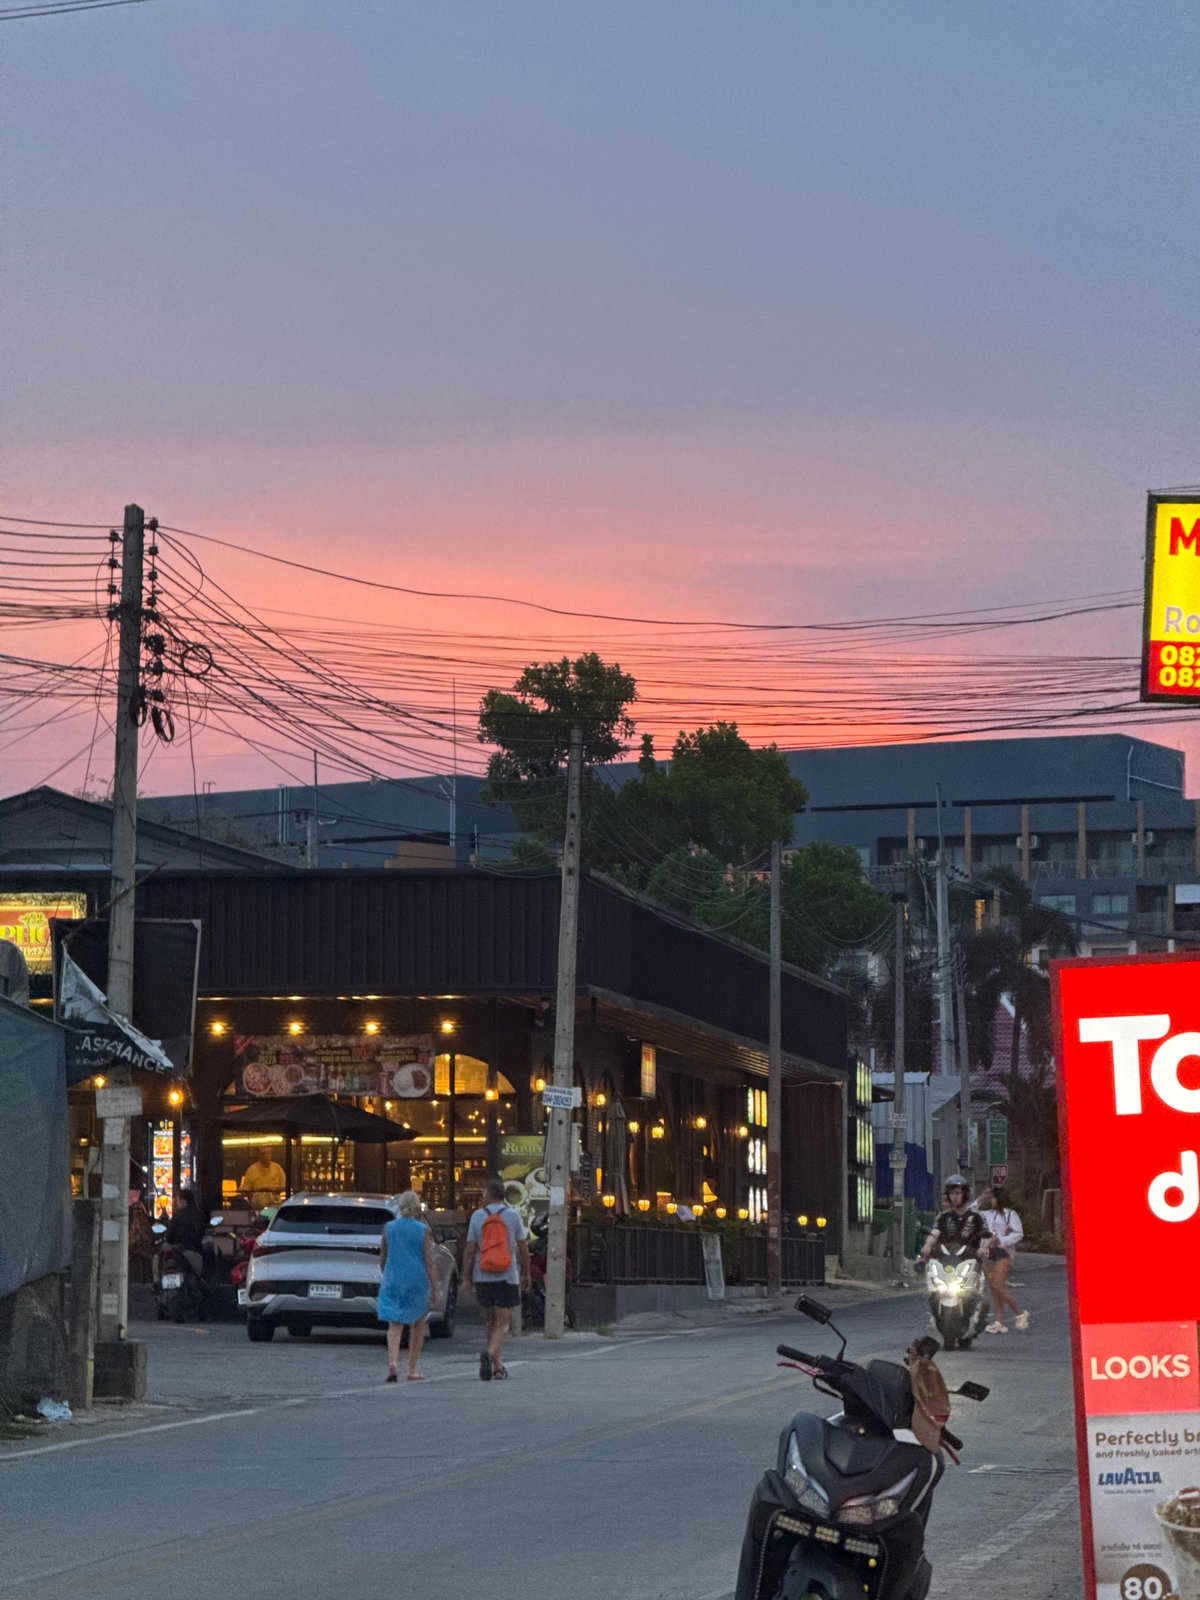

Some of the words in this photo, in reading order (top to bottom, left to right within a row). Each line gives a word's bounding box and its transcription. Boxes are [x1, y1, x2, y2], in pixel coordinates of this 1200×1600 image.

[1169, 517, 1200, 556] M
[1164, 606, 1200, 634] Ro
[1079, 1014, 1200, 1115] To
[1090, 1354, 1191, 1380] LOOKS
[1095, 1428, 1179, 1447] Perfectly
[1096, 1450, 1113, 1458] and
[1116, 1448, 1150, 1458] freshly
[1153, 1447, 1182, 1457] baked
[1098, 1467, 1162, 1486] LAVAZZA
[1124, 1576, 1163, 1600] 80
